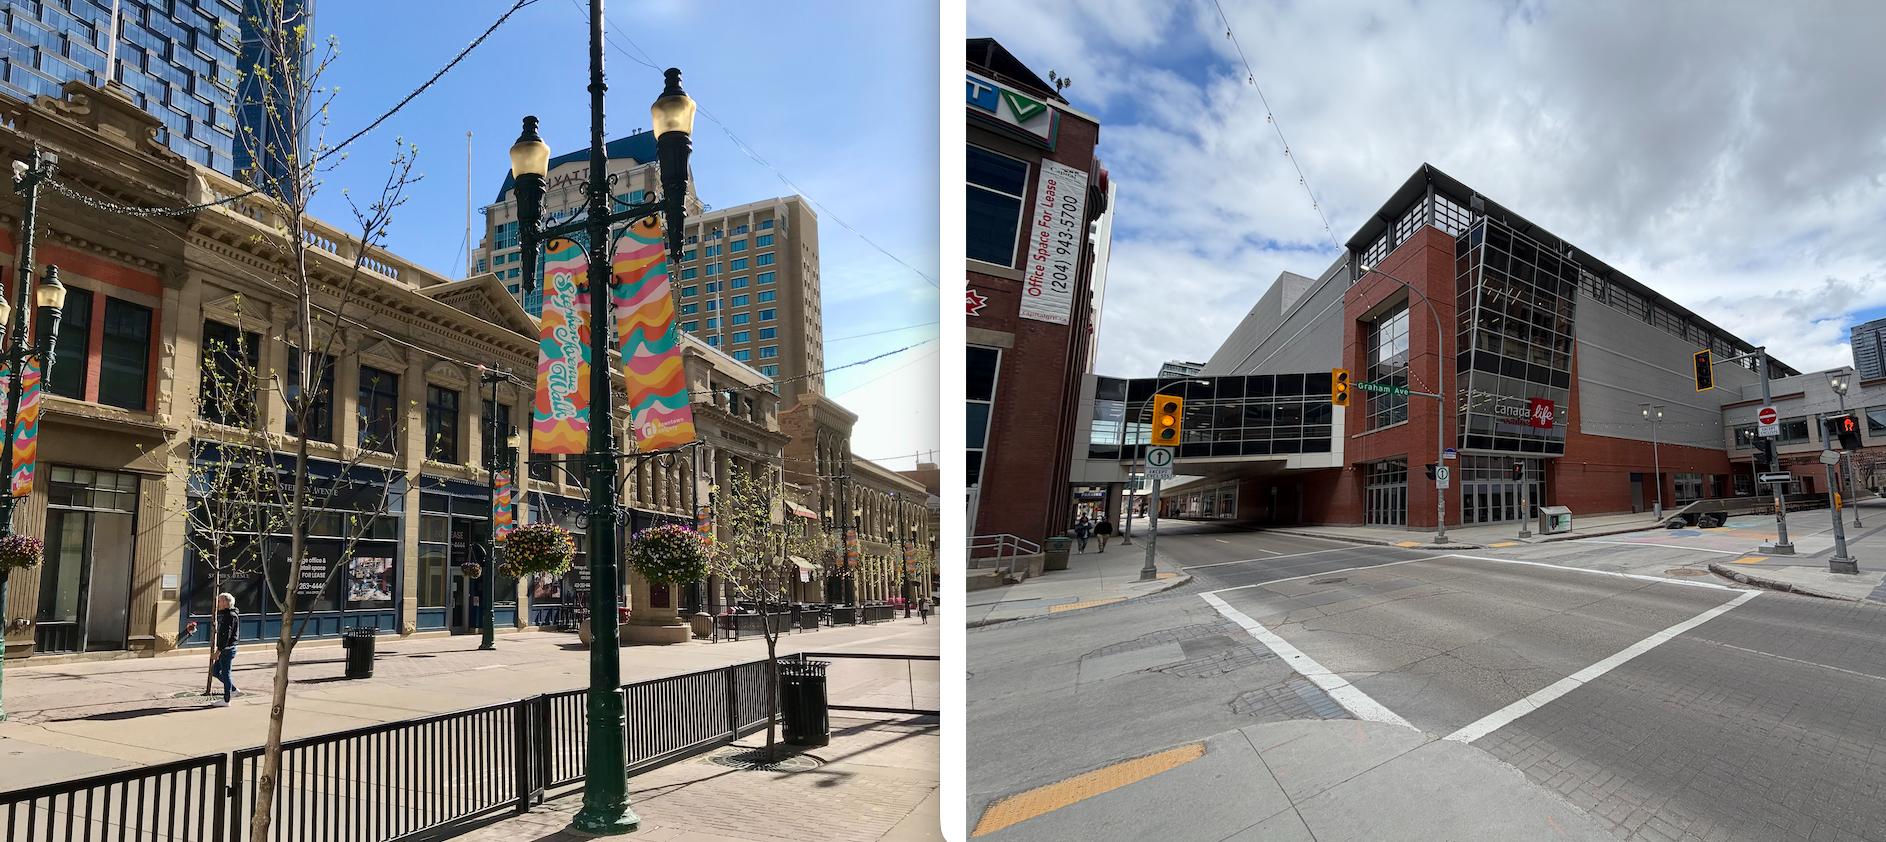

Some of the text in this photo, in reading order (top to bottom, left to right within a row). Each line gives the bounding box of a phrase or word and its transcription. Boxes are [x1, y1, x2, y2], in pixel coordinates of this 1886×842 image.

[1028, 179, 1057, 297] Office Space For Lease
[1056, 195, 1078, 255] 943-5700
[1051, 260, 1072, 294] (204)
[552, 274, 583, 391] Stephen Avenue
[549, 364, 575, 419] Walk
[1357, 382, 1409, 395] Graham Ave
[658, 417, 685, 427] downtown
[1494, 404, 1553, 425] canada life
[1504, 418, 1530, 427] centre
[658, 425, 678, 433] calgary
